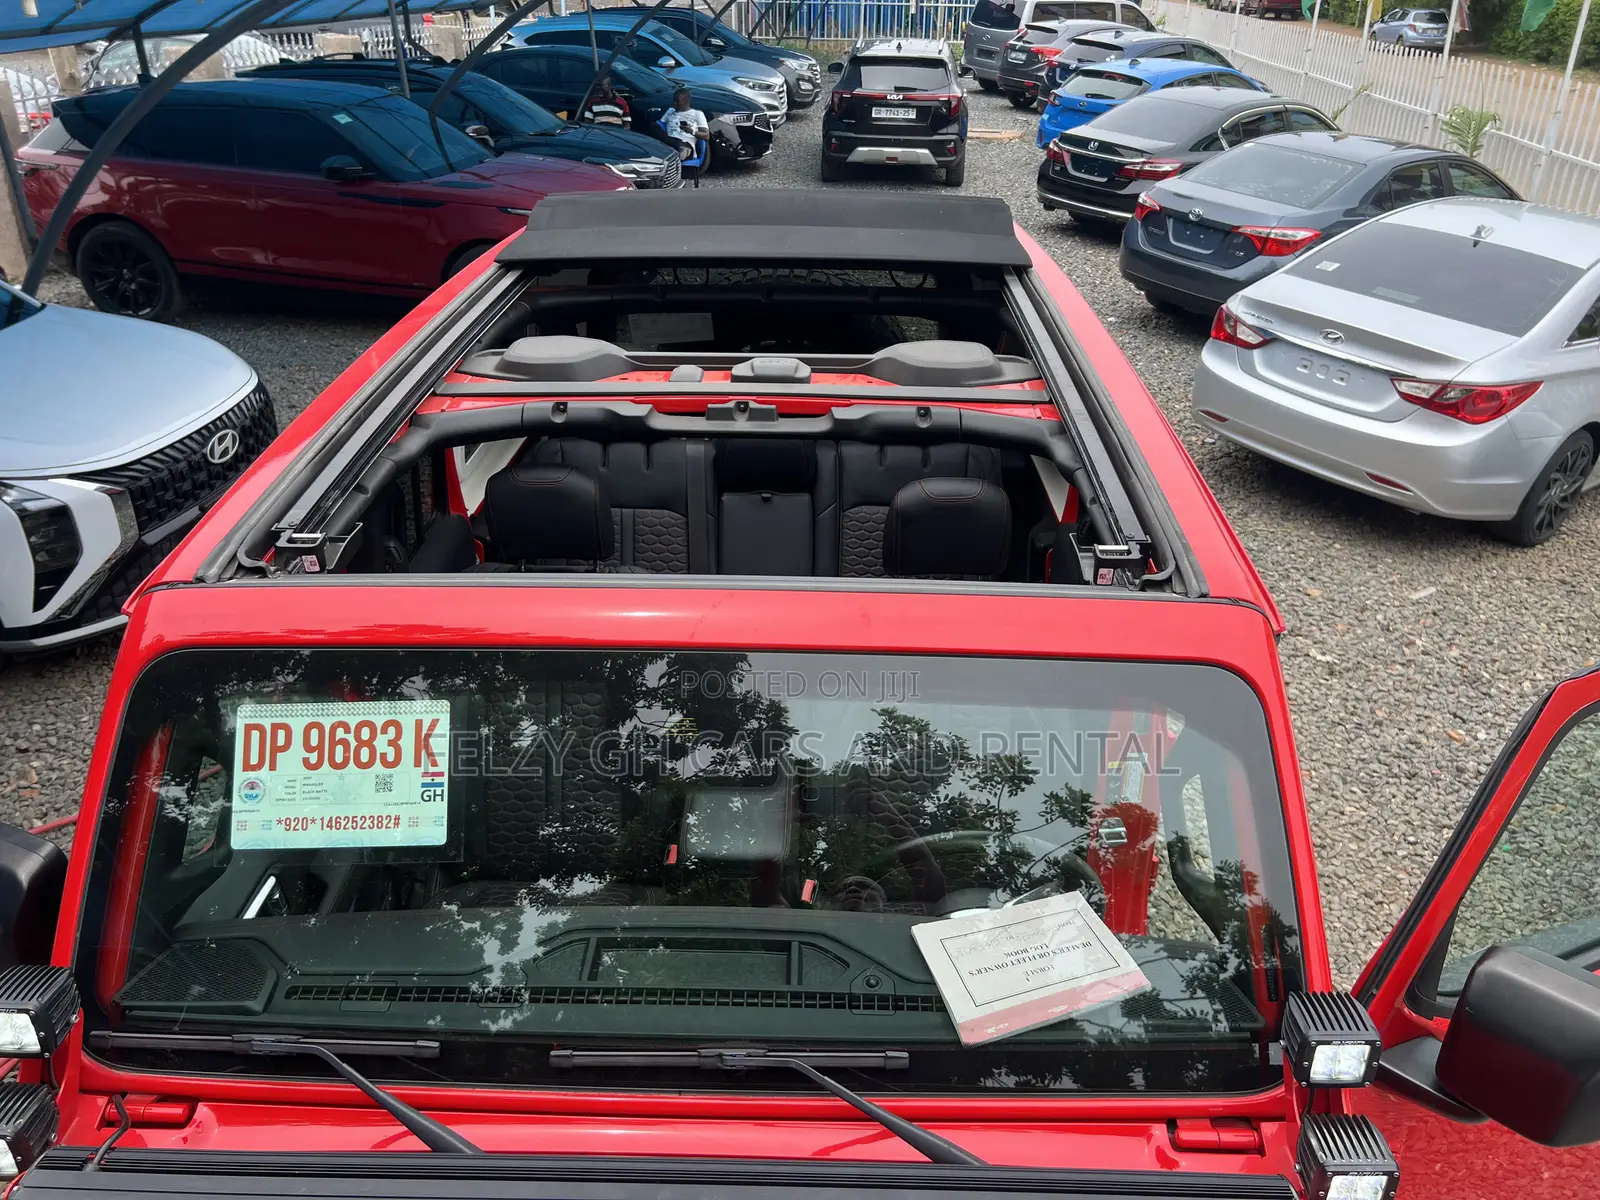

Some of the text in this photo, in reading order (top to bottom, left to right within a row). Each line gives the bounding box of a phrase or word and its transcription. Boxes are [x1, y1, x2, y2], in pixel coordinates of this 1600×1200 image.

[242, 718, 441, 772] DP 9683 K
[420, 789, 445, 803] GH
